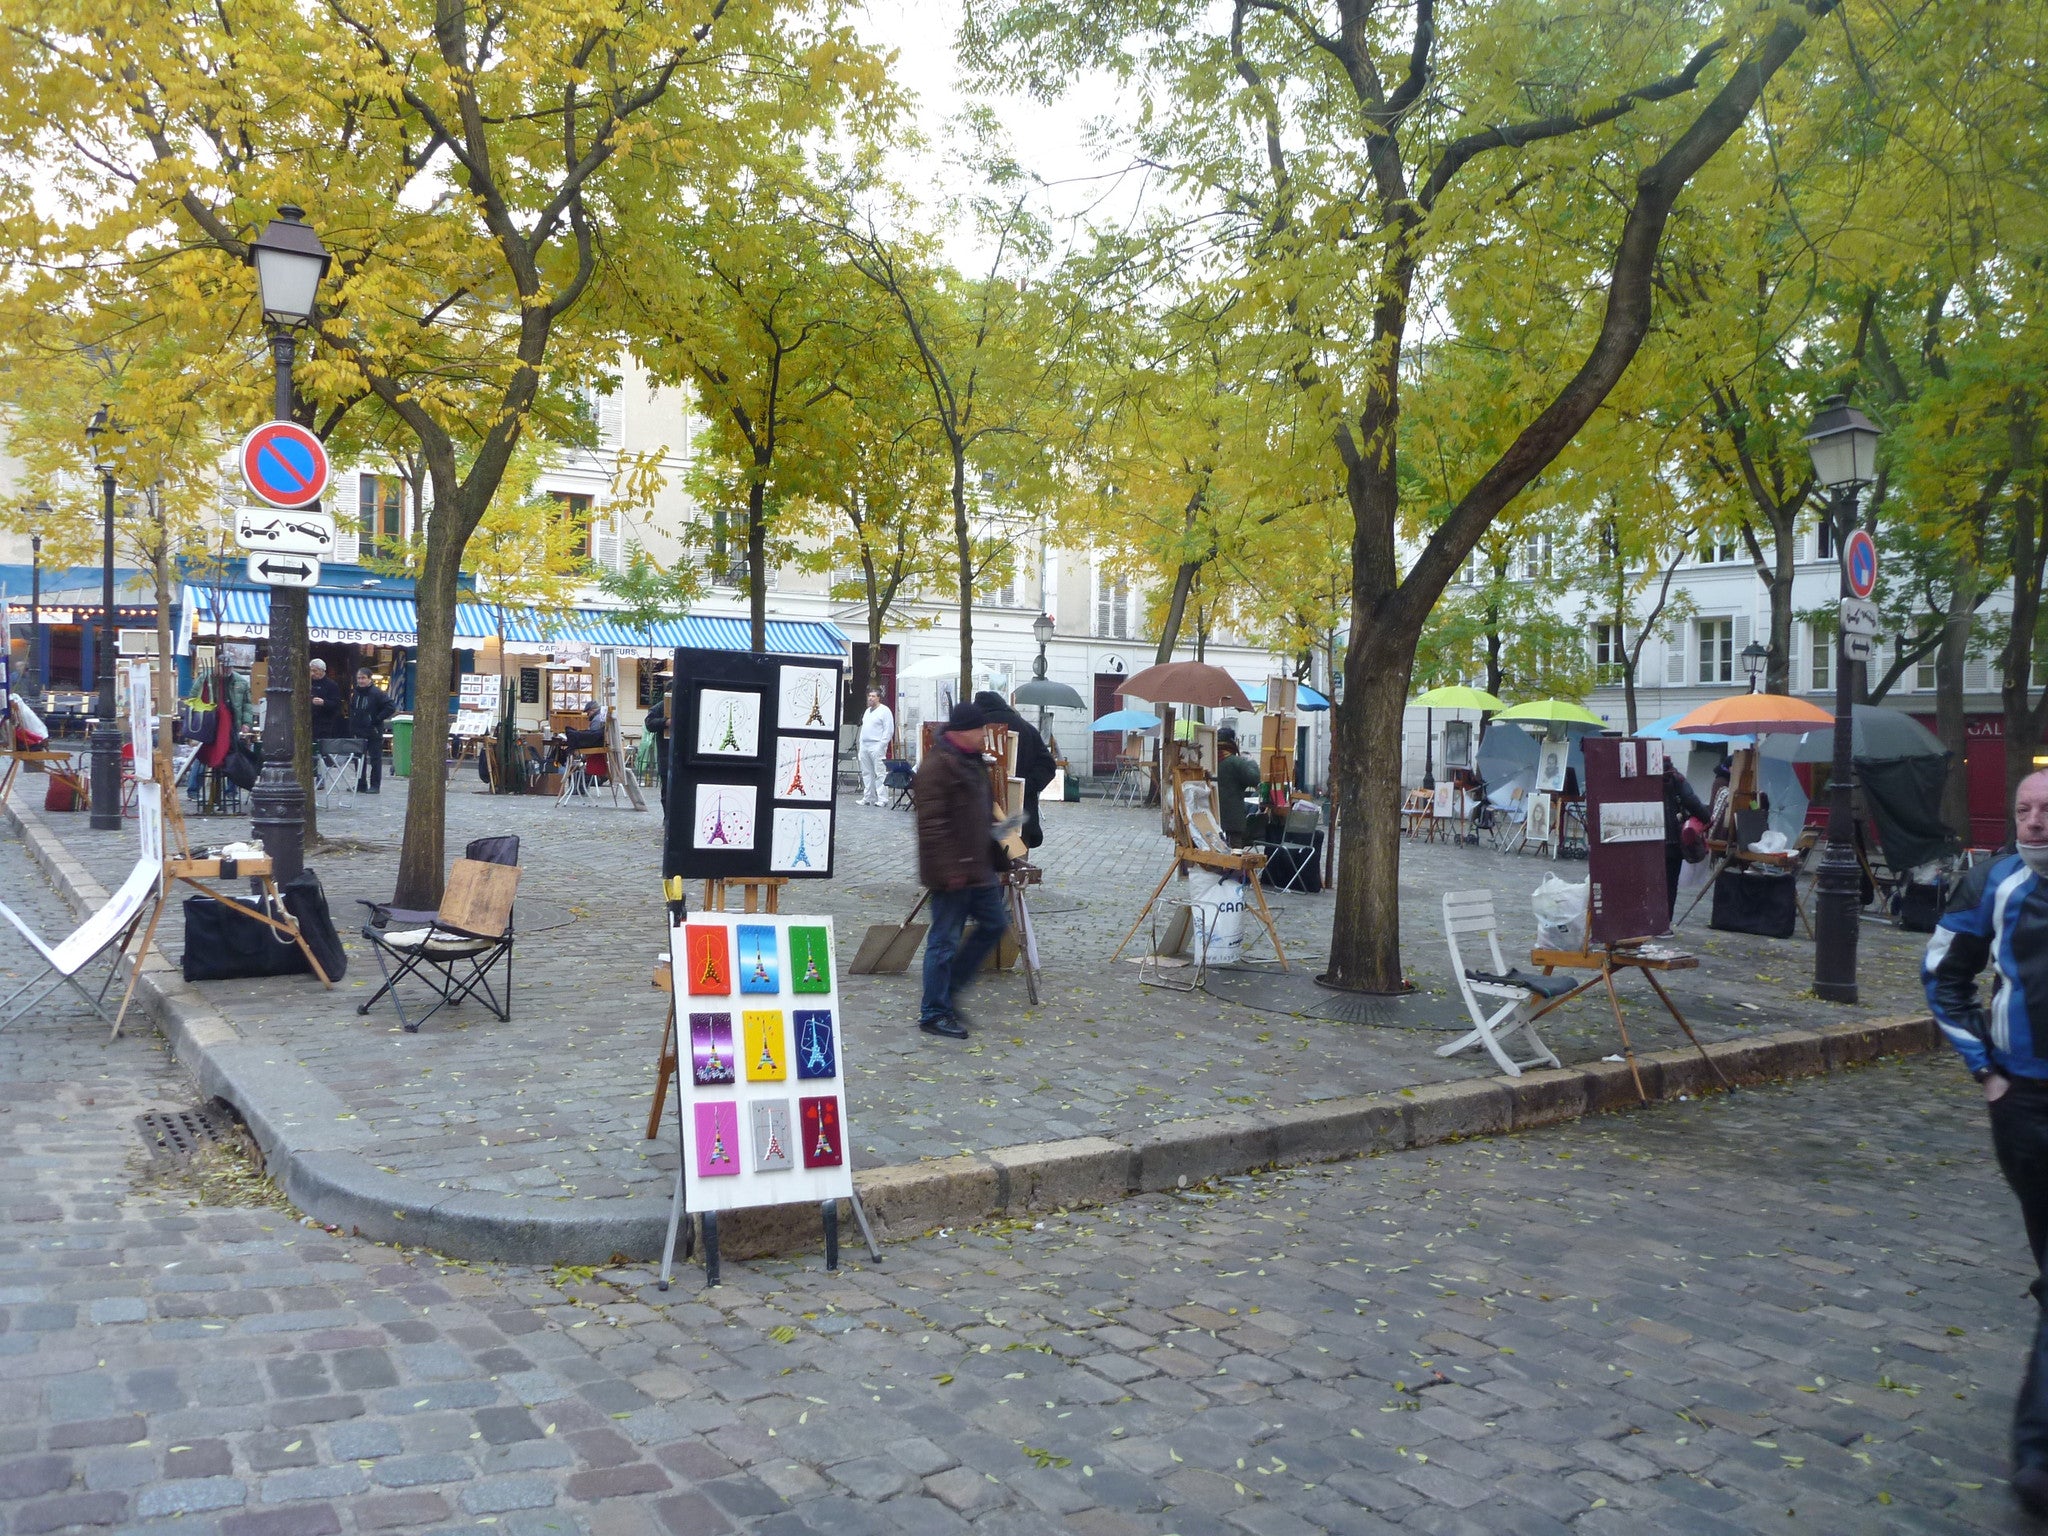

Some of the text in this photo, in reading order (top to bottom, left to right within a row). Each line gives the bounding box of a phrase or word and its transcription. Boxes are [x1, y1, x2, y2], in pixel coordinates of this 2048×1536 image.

[245, 625, 418, 643] AU ON DES CHASSE
[538, 644, 556, 652] CAF
[1967, 722, 2002, 735] GAL
[1220, 902, 1245, 913] CAN
